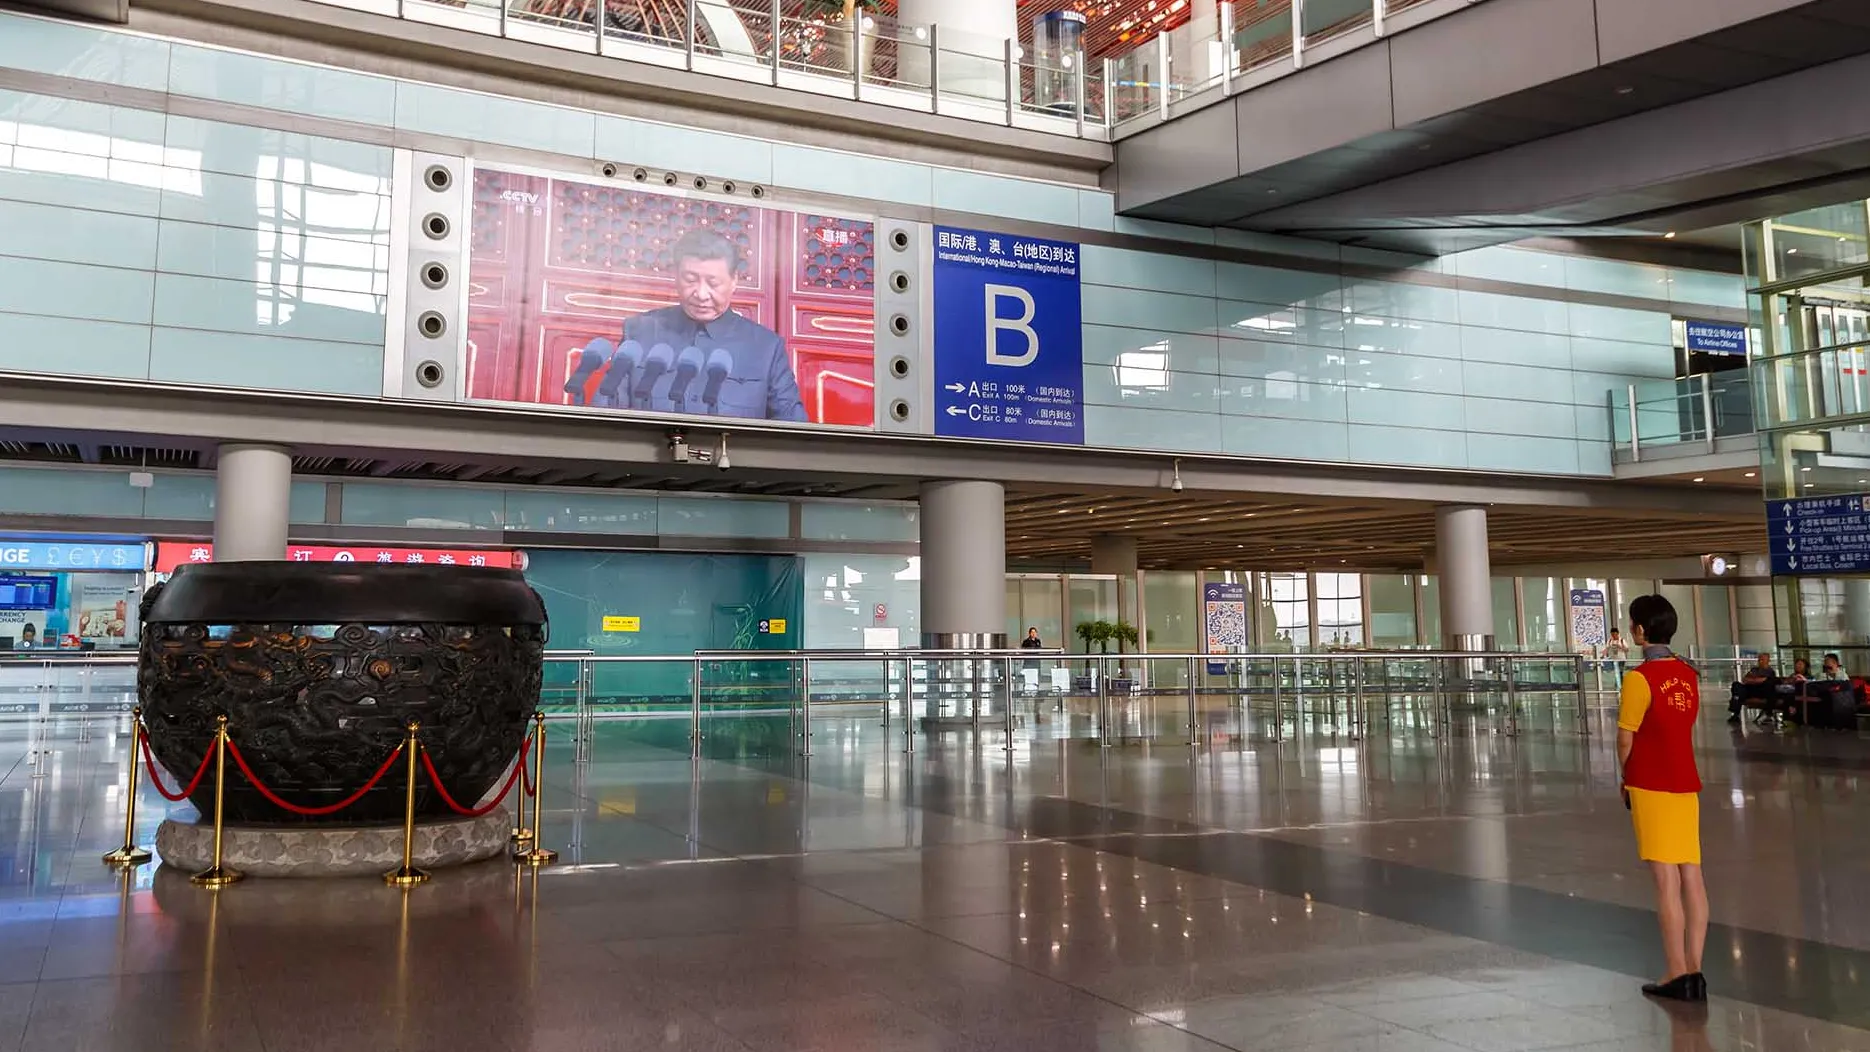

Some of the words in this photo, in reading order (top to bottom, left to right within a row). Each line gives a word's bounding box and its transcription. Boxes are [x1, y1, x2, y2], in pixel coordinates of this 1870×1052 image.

[502, 190, 538, 203] CCTV
[822, 229, 849, 245] 直播
[984, 283, 1040, 367] B
[1704, 339, 1719, 347] Airline
[1720, 340, 1738, 348] Offices
[968, 381, 980, 398] A
[982, 382, 998, 392] 出口
[1005, 384, 1026, 393] 100米
[982, 391, 994, 399] Exit
[968, 404, 981, 421] C
[982, 404, 998, 414] 出口
[1005, 406, 1023, 416] 80米
[1004, 416, 1018, 424] 80m
